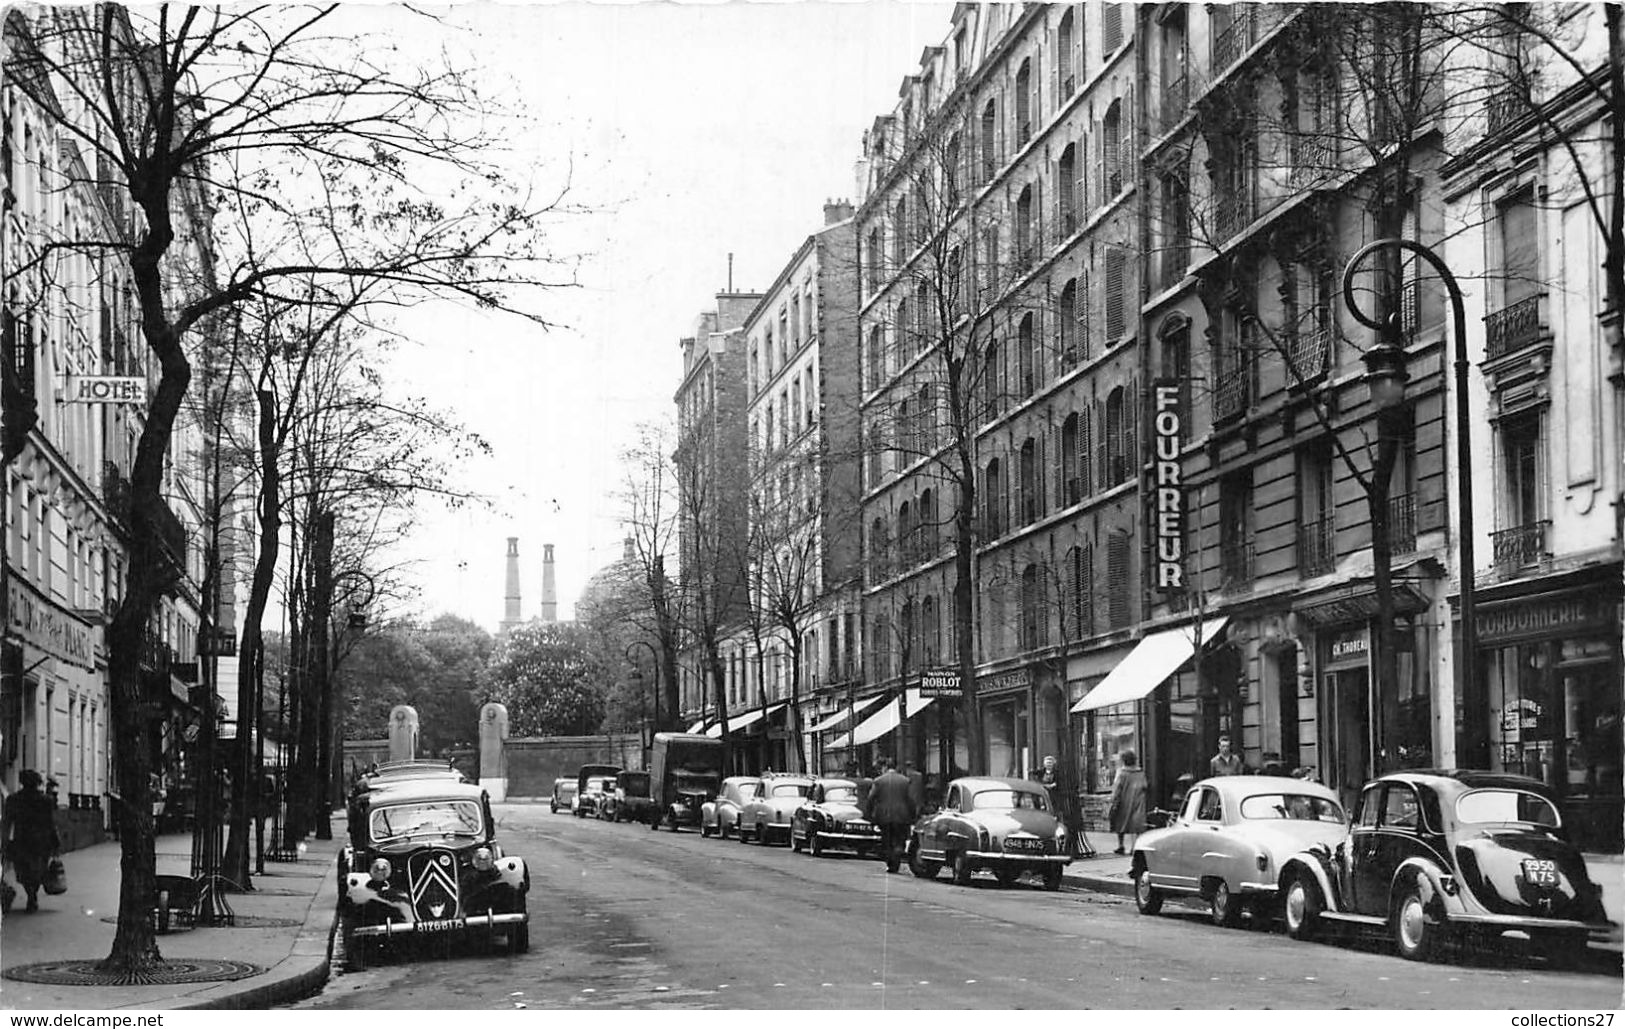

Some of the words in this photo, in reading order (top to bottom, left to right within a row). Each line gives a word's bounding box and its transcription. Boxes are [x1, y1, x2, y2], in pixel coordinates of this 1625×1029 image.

[80, 380, 141, 399] HOTEL
[1155, 386, 1182, 588] FOURREUR
[922, 676, 961, 688] ROBLOT
[1539, 871, 1555, 882] 75
